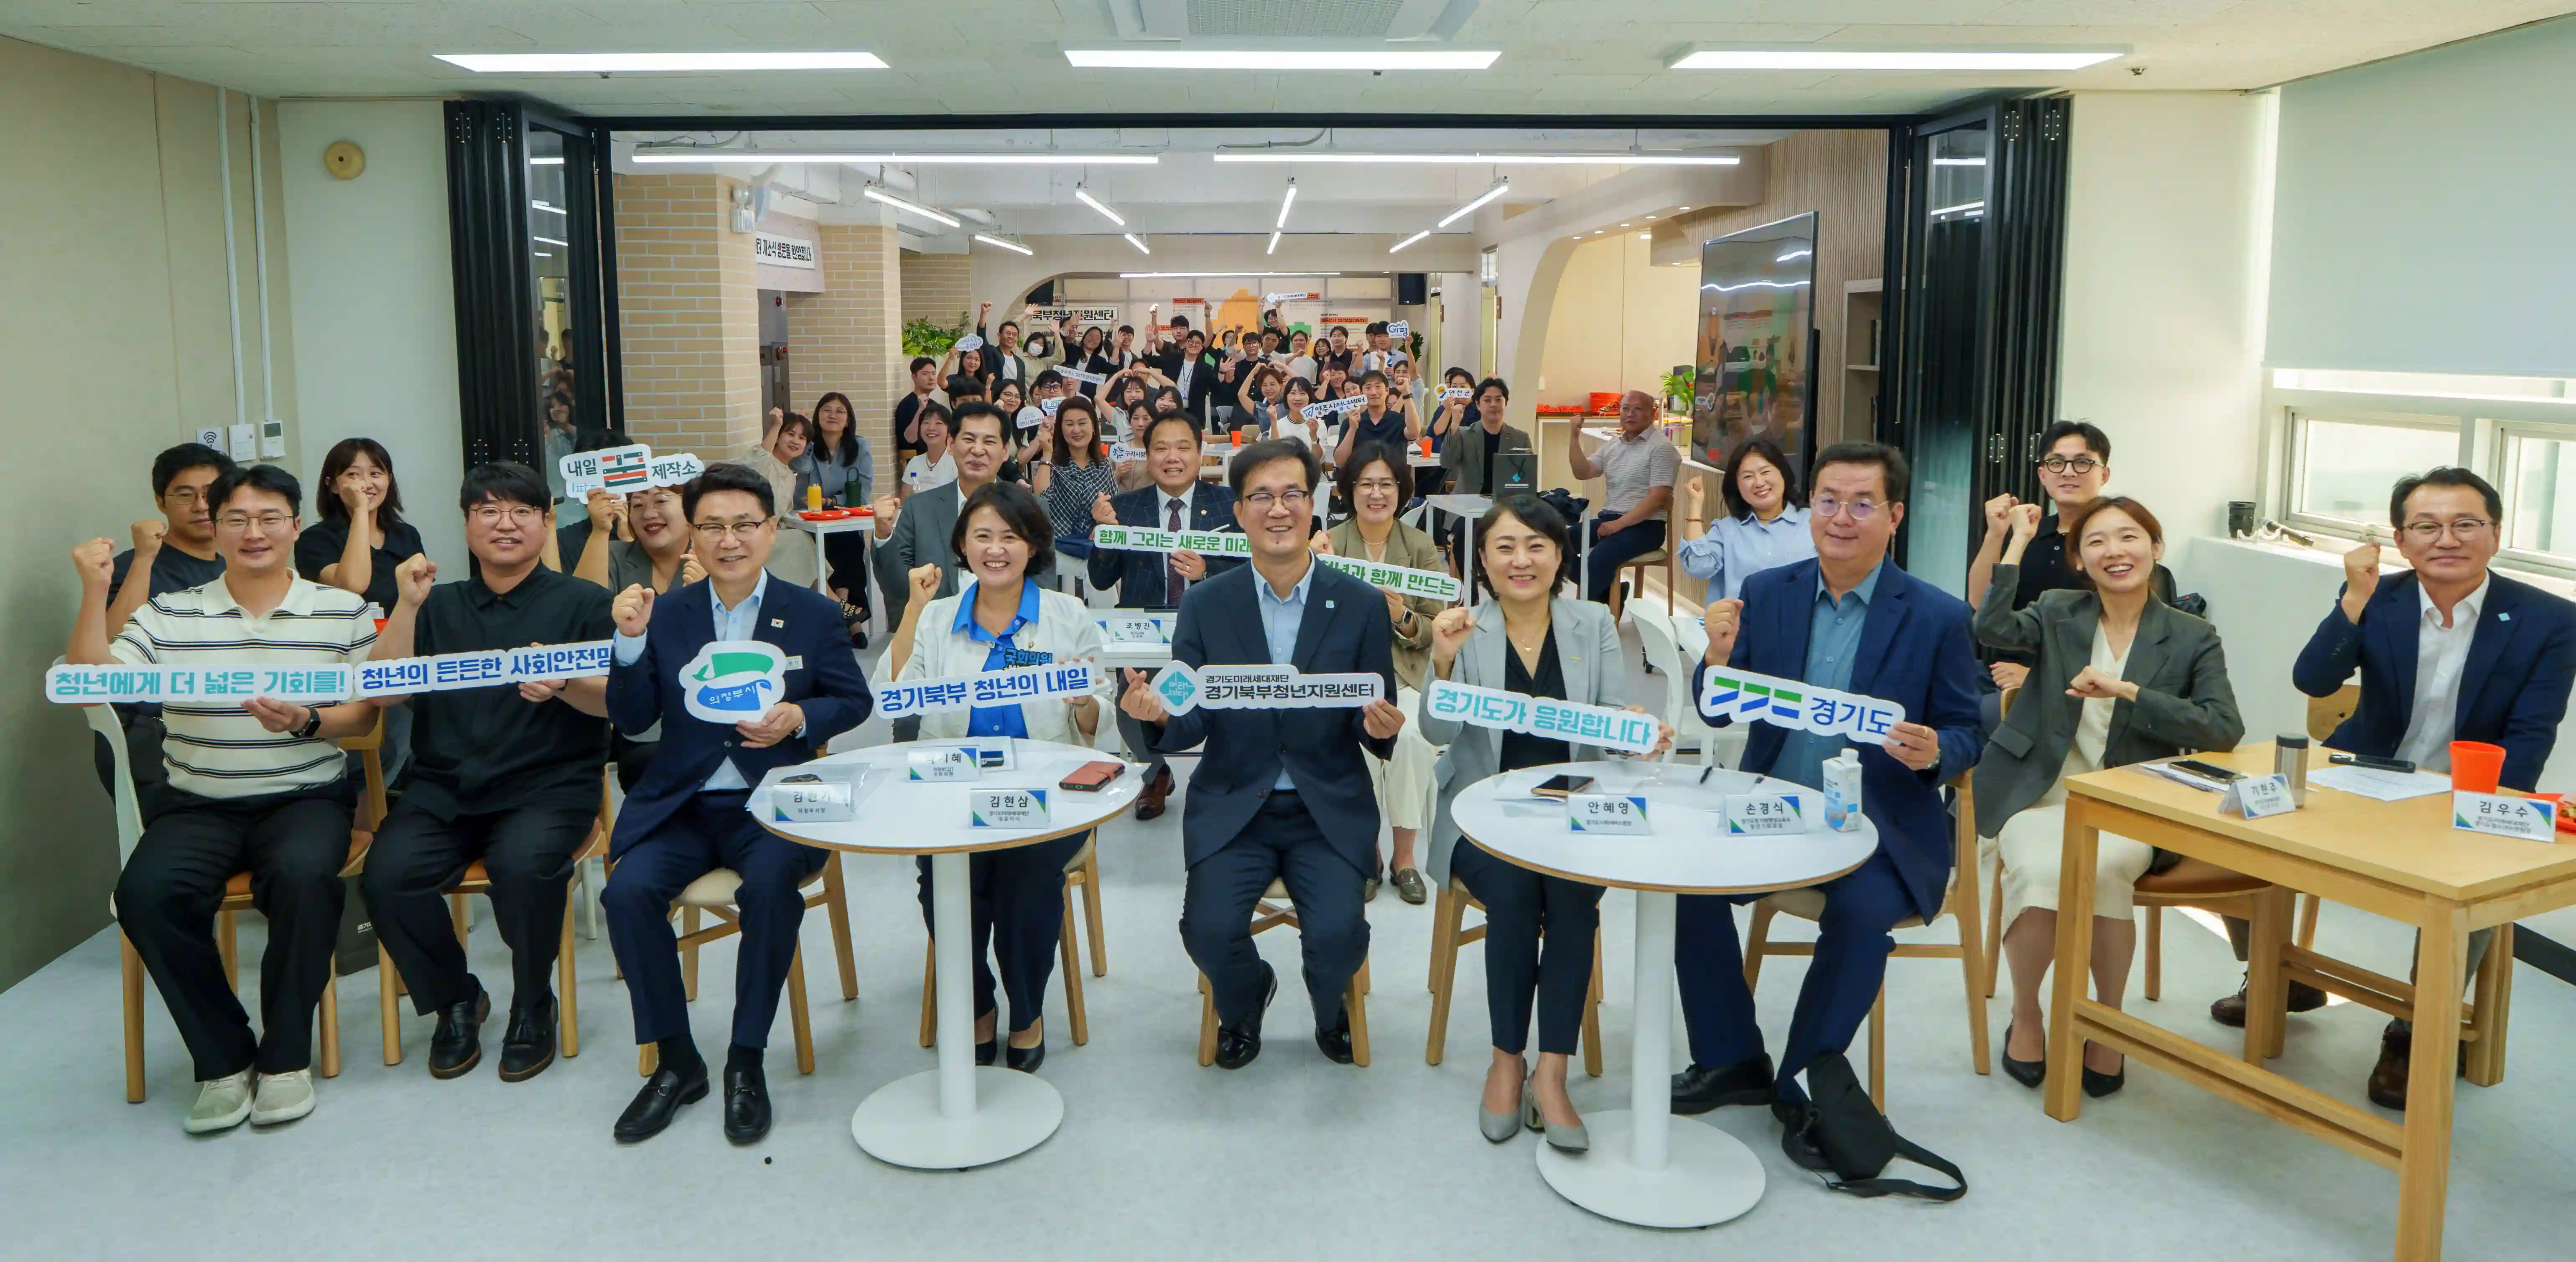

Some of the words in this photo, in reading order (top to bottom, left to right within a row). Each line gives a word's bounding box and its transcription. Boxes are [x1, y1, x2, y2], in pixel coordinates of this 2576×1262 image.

[763, 239, 776, 257] 개소식
[777, 242, 791, 260] 방문을
[1031, 310, 1113, 321] 북부청년원센터
[567, 458, 597, 477] 내일
[652, 461, 697, 480] 제작소
[1099, 529, 1127, 545] 함께
[1132, 531, 1174, 549] 그리는
[1178, 534, 1220, 551] 새로운
[1225, 537, 1252, 553] 미래
[1370, 568, 1403, 588] 함께
[1406, 574, 1456, 596] 만드는
[55, 672, 161, 695] 청년에게
[171, 671, 195, 695] 더
[205, 671, 254, 694] 넓은
[263, 671, 345, 694] 기회를!
[362, 663, 428, 690] 청년의
[437, 657, 502, 683] 든든한
[1205, 674, 1289, 683] 경기도미래세대재단
[710, 685, 756, 705] 의정부시
[881, 682, 967, 712] 경기북부
[973, 673, 1039, 701] 청년의
[1046, 667, 1089, 693] 내일
[1205, 683, 1375, 700] 경기북부청년지원센터
[1435, 688, 1526, 725] 경기도가
[1534, 705, 1651, 746] 응원합니다
[1810, 697, 1893, 735] 경기도
[990, 795, 1029, 808] 김현삼
[1588, 801, 1628, 814] 안혜영
[1745, 802, 1783, 815] 손경식
[2479, 801, 2529, 818] 김우수
